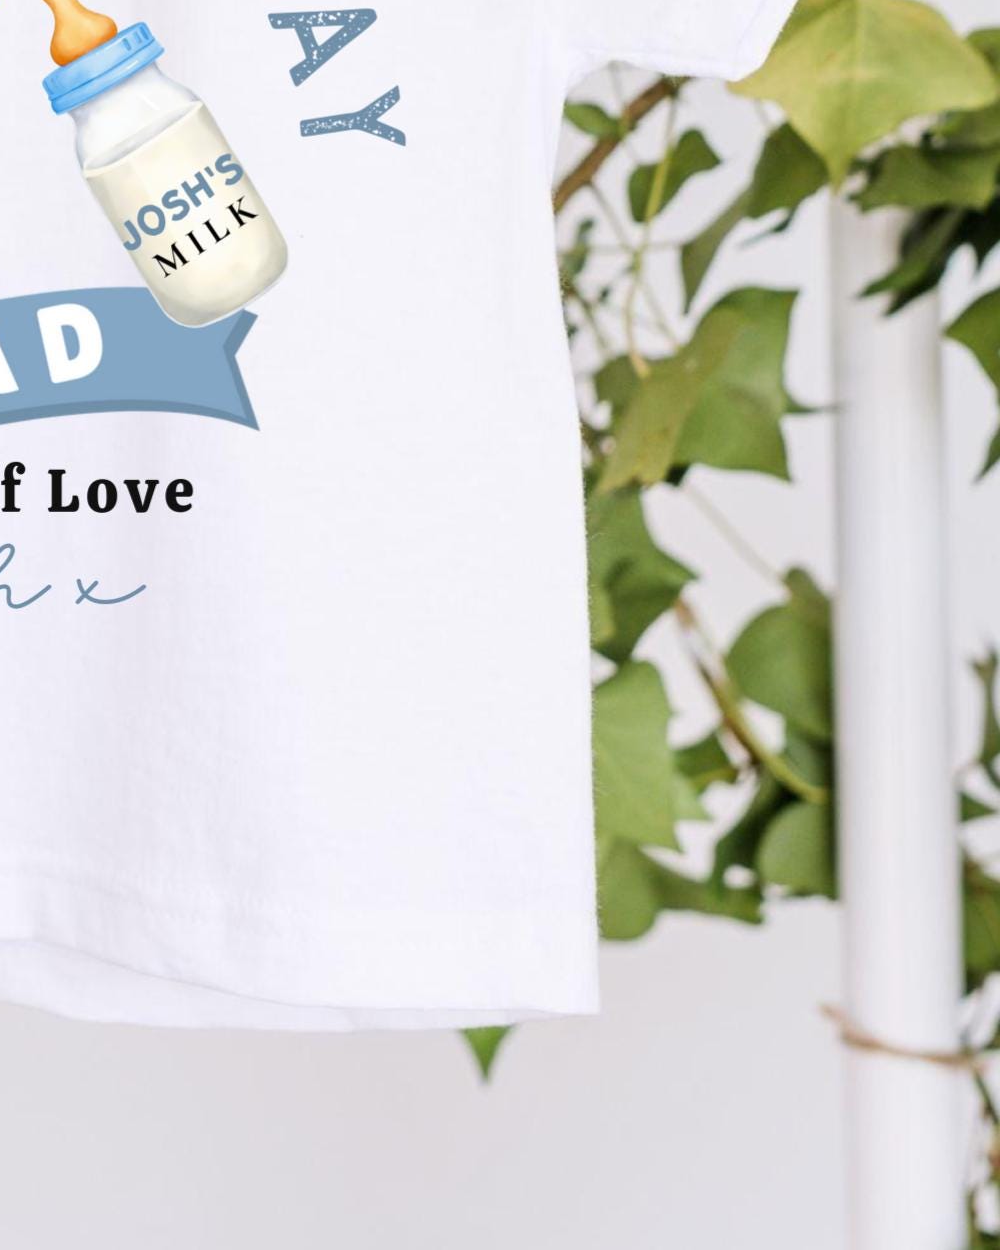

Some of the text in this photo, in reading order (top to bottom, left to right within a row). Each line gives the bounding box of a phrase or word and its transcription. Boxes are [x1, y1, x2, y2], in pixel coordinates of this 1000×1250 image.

[123, 153, 244, 251] JOSH'S
[152, 196, 259, 278] MILK
[48, 469, 194, 513] Love
